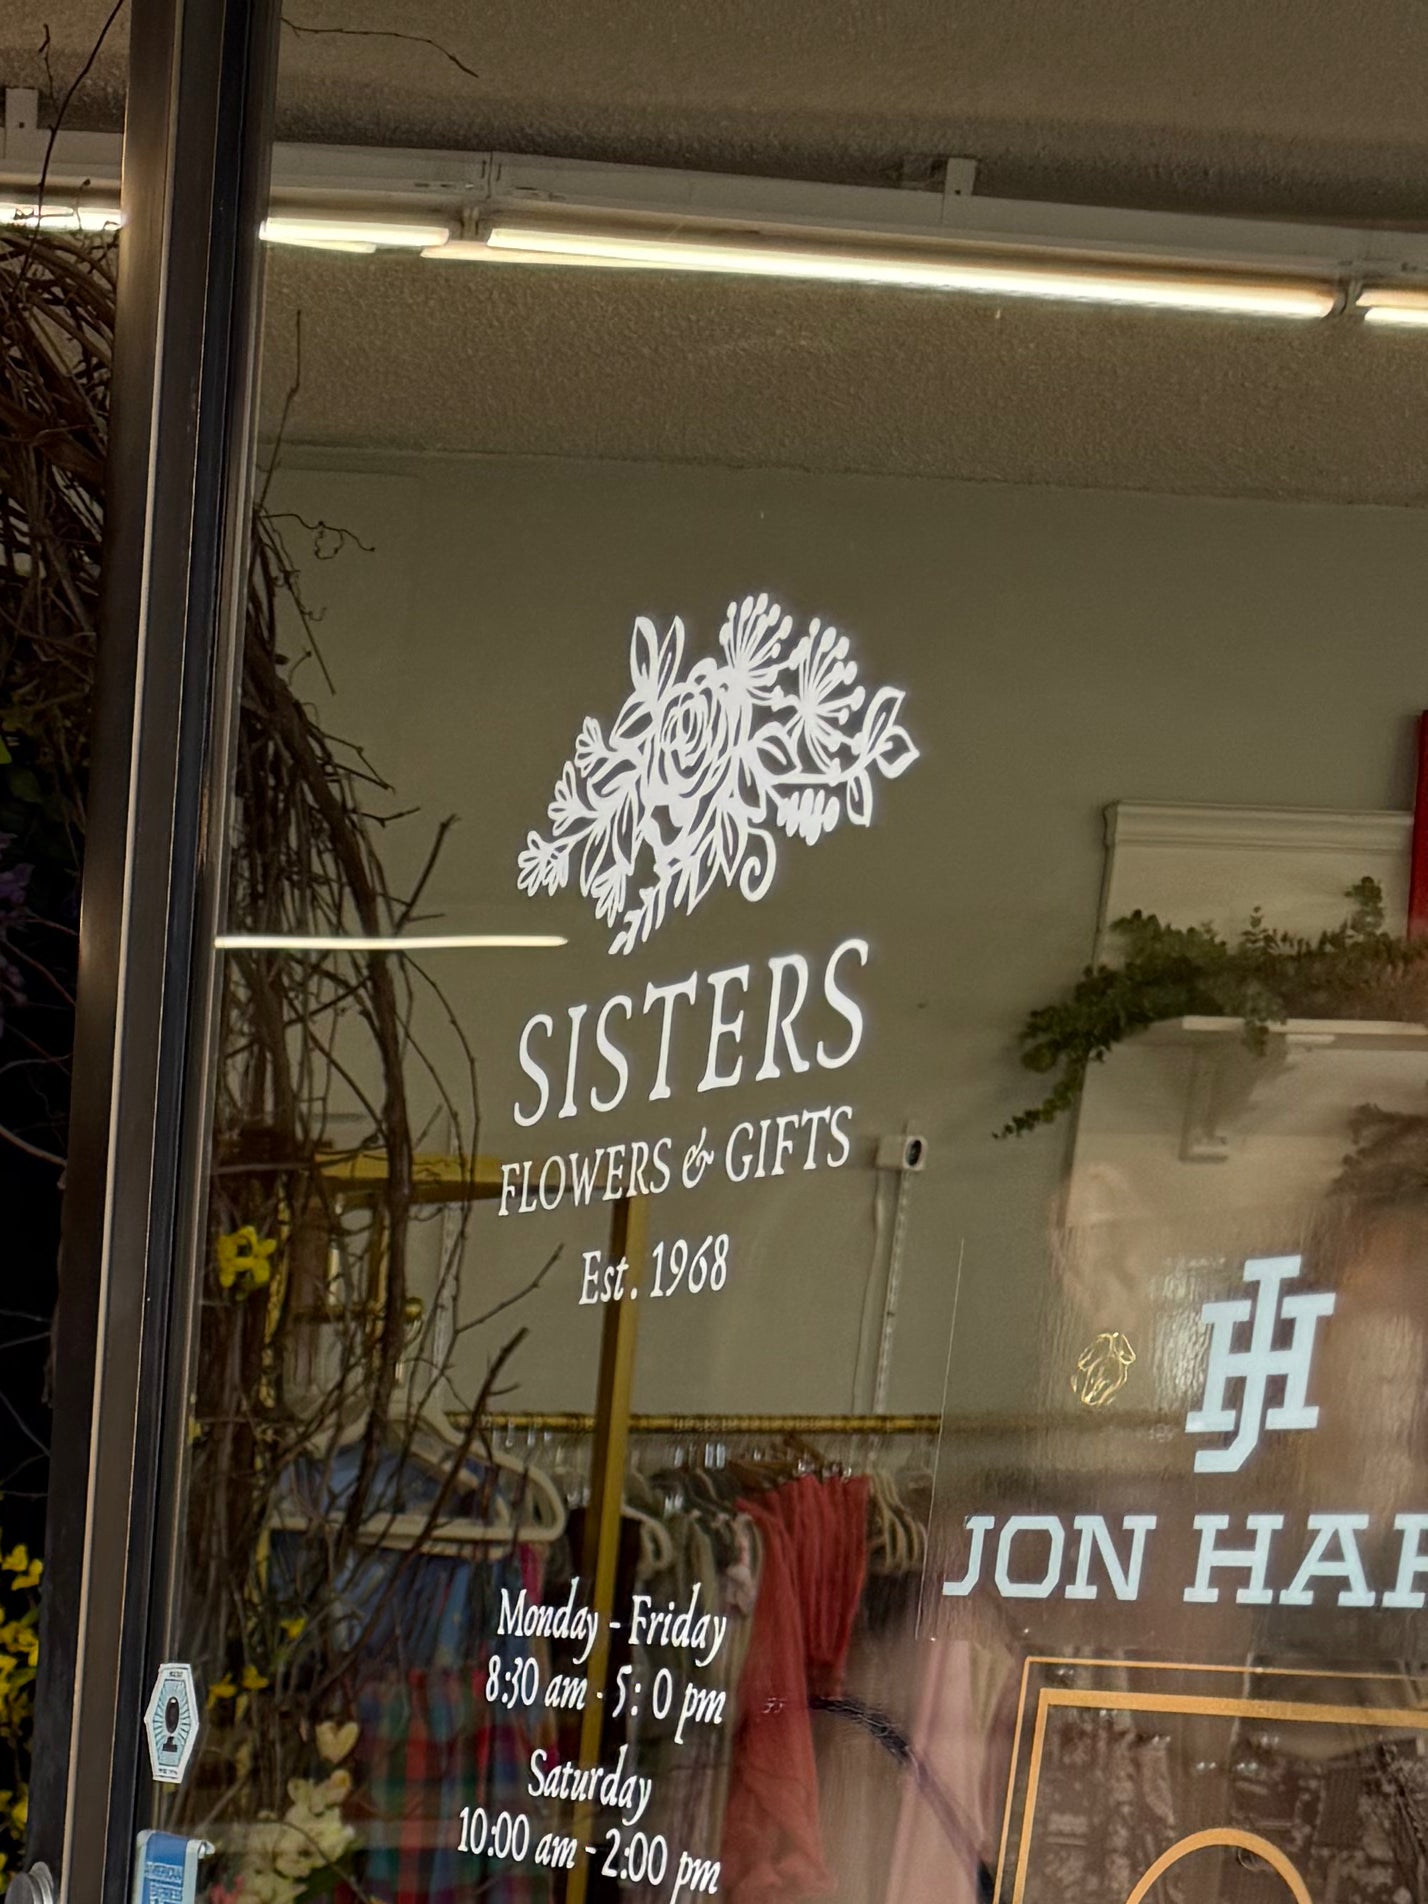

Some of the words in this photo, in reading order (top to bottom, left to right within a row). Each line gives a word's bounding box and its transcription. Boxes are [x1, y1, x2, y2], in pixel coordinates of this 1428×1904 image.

[513, 938, 869, 1128] SISTERS
[498, 1137, 672, 1216] FLOWERS
[682, 1126, 714, 1189] &
[725, 1104, 853, 1183] GIFTS
[578, 1249, 638, 1305] Est.
[650, 1233, 730, 1298] 1968
[942, 1514, 1157, 1602] JON
[497, 1576, 598, 1665] Monday
[628, 1582, 727, 1667] Friday
[486, 1655, 539, 1709] 8:30
[545, 1674, 588, 1710] am
[674, 1682, 727, 1745] pm
[528, 1743, 652, 1827] Saturday
[457, 1807, 530, 1862] 10:00
[534, 1833, 578, 1869] am
[601, 1828, 668, 1886] 2:00
